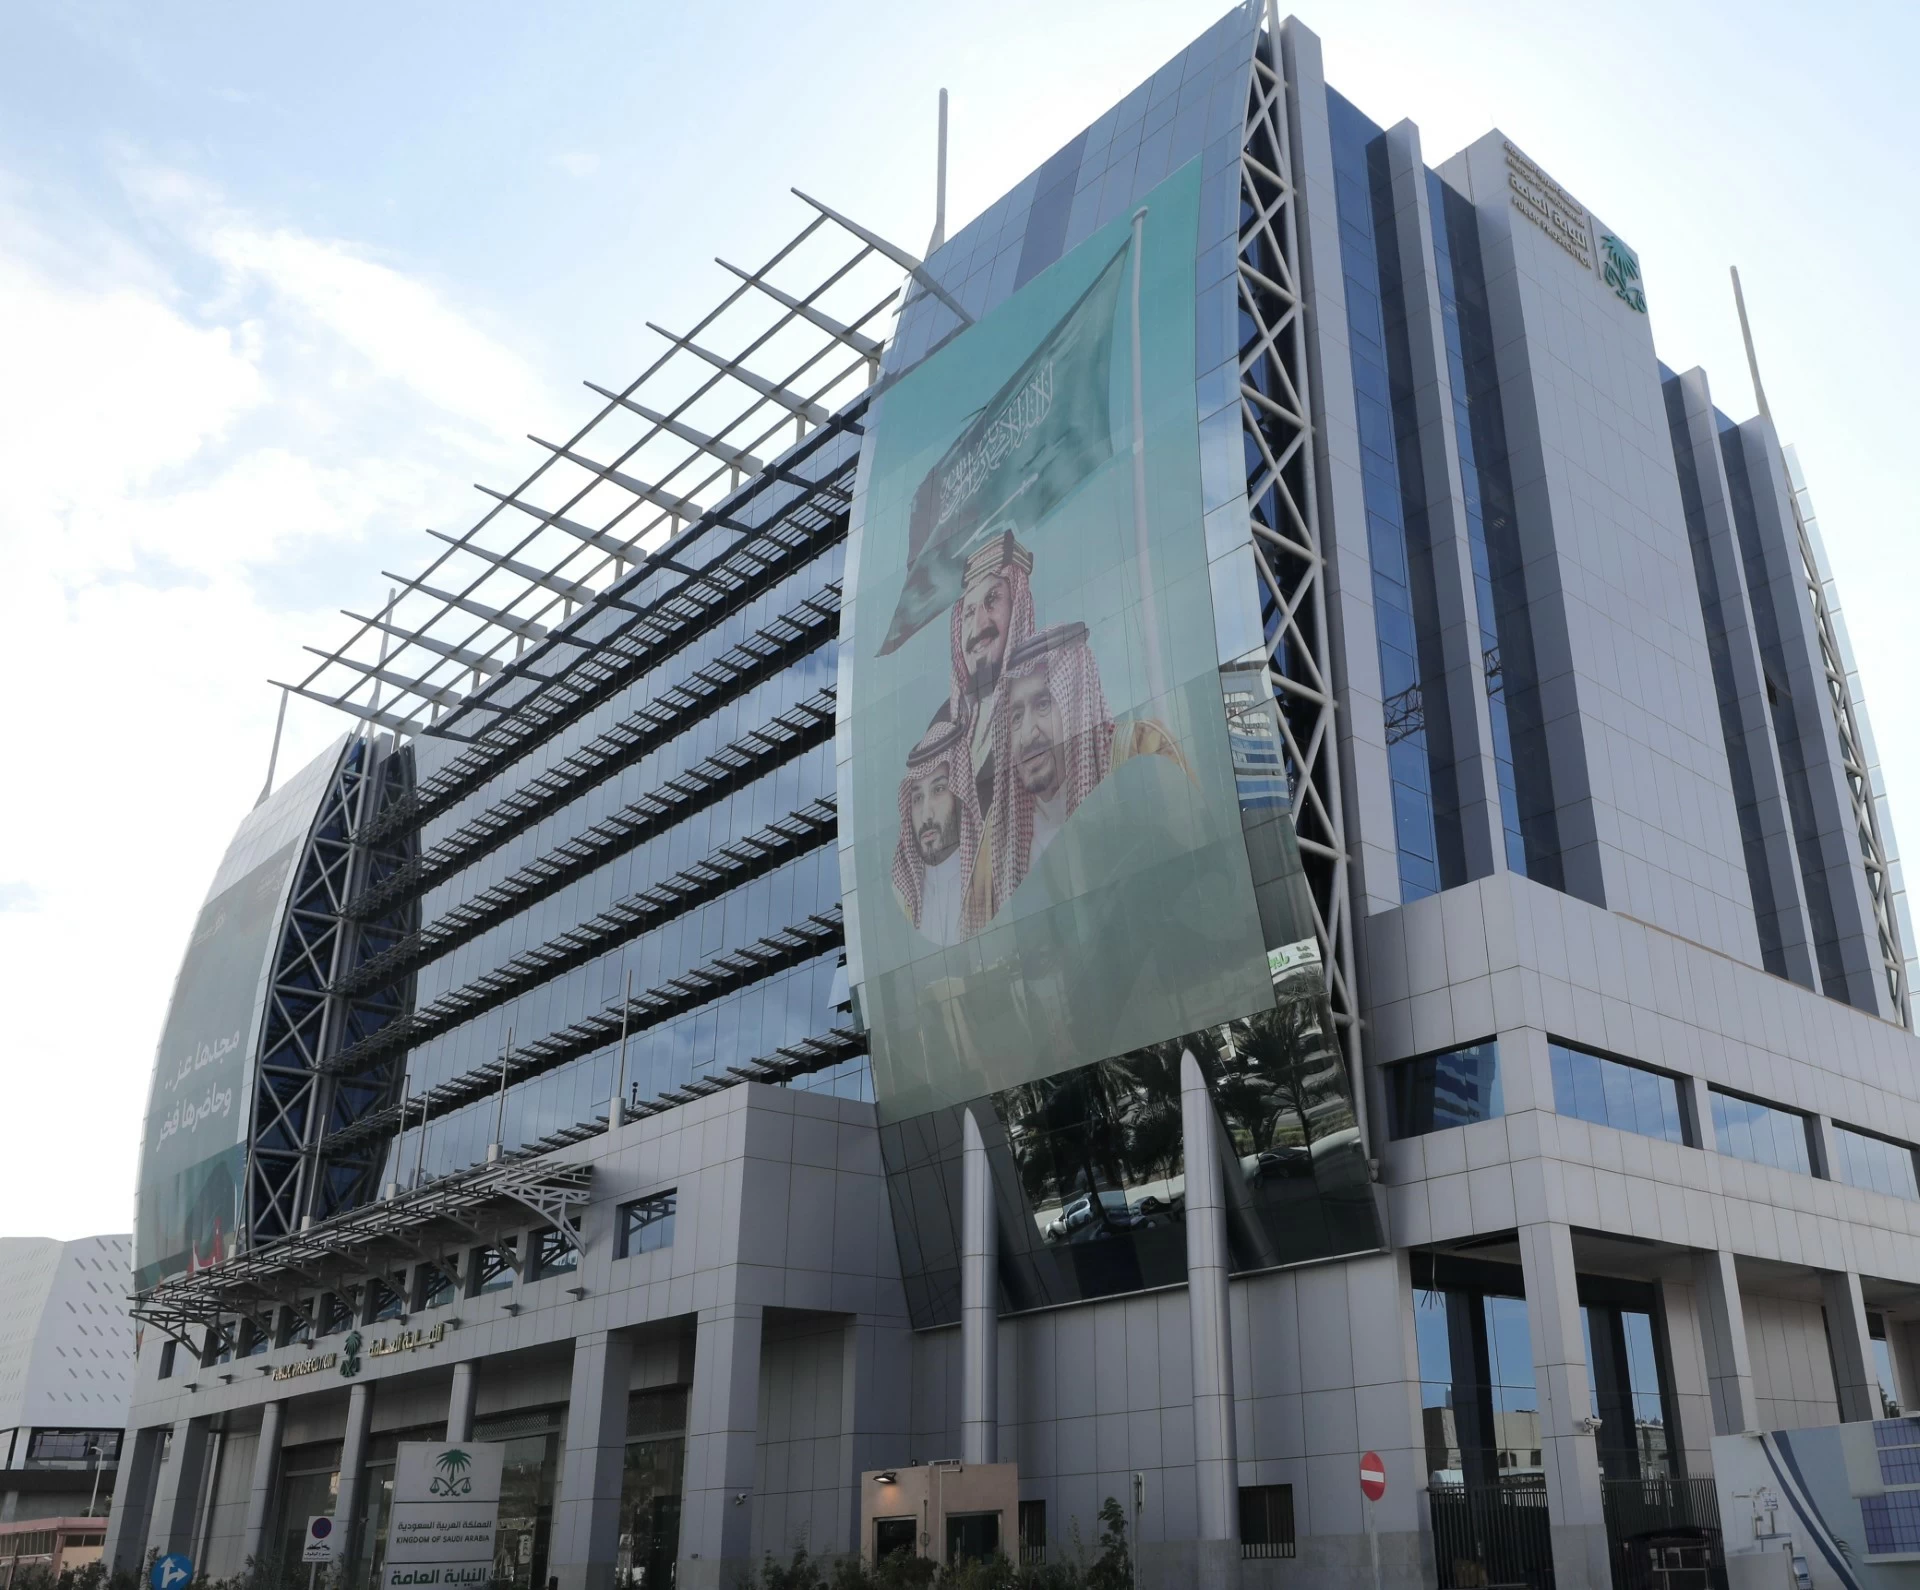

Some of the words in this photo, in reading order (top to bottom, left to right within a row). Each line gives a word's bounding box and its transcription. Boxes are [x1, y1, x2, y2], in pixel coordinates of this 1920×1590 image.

[1509, 172, 1550, 218] العامة
[1511, 195, 1539, 226] PUBLIC
[1540, 219, 1592, 270] PROSECUTION
[1552, 210, 1588, 252] النيابة
[292, 1353, 337, 1376] PROSECUTION
[398, 1522, 435, 1532] السعودية
[436, 1521, 461, 1532] العربية
[463, 1520, 492, 1529] المملكة
[443, 1535, 463, 1543] SAUDI
[465, 1534, 489, 1542] ARABIA
[391, 1569, 440, 1585] العامة
[444, 1567, 487, 1587] النيابة
